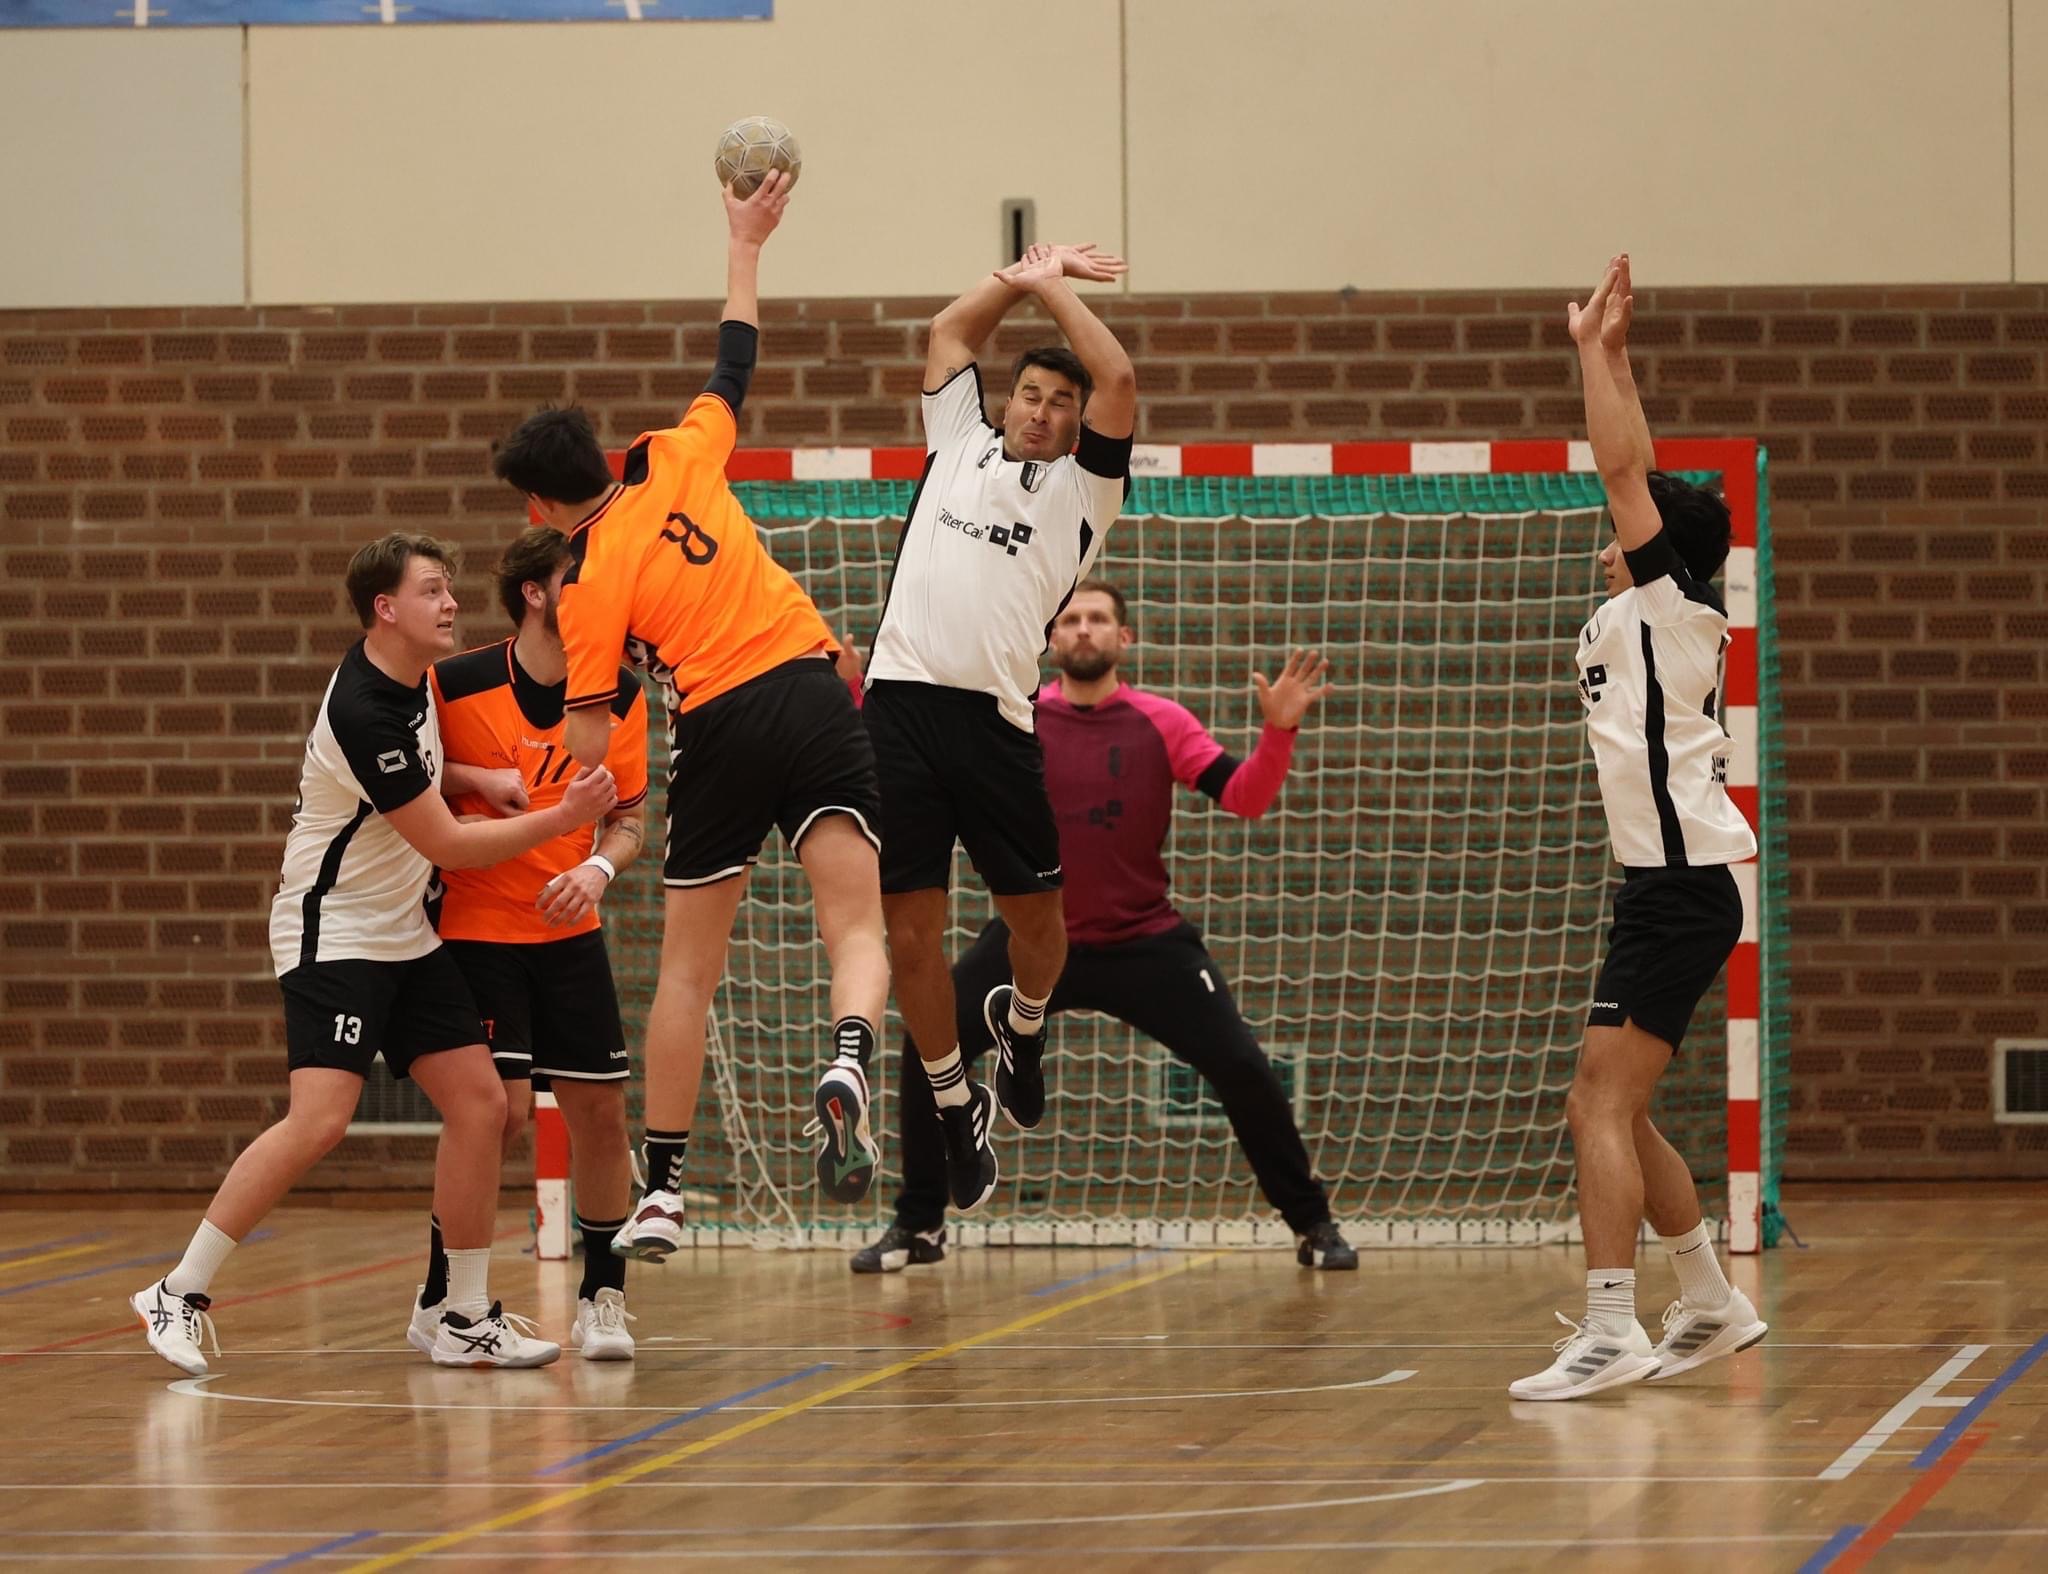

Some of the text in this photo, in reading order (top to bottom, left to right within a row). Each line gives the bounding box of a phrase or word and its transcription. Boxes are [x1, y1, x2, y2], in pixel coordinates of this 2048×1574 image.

[978, 447, 999, 469] 8
[660, 512, 718, 566] 8
[1199, 969, 1216, 992] 1
[334, 1014, 362, 1045] 13
